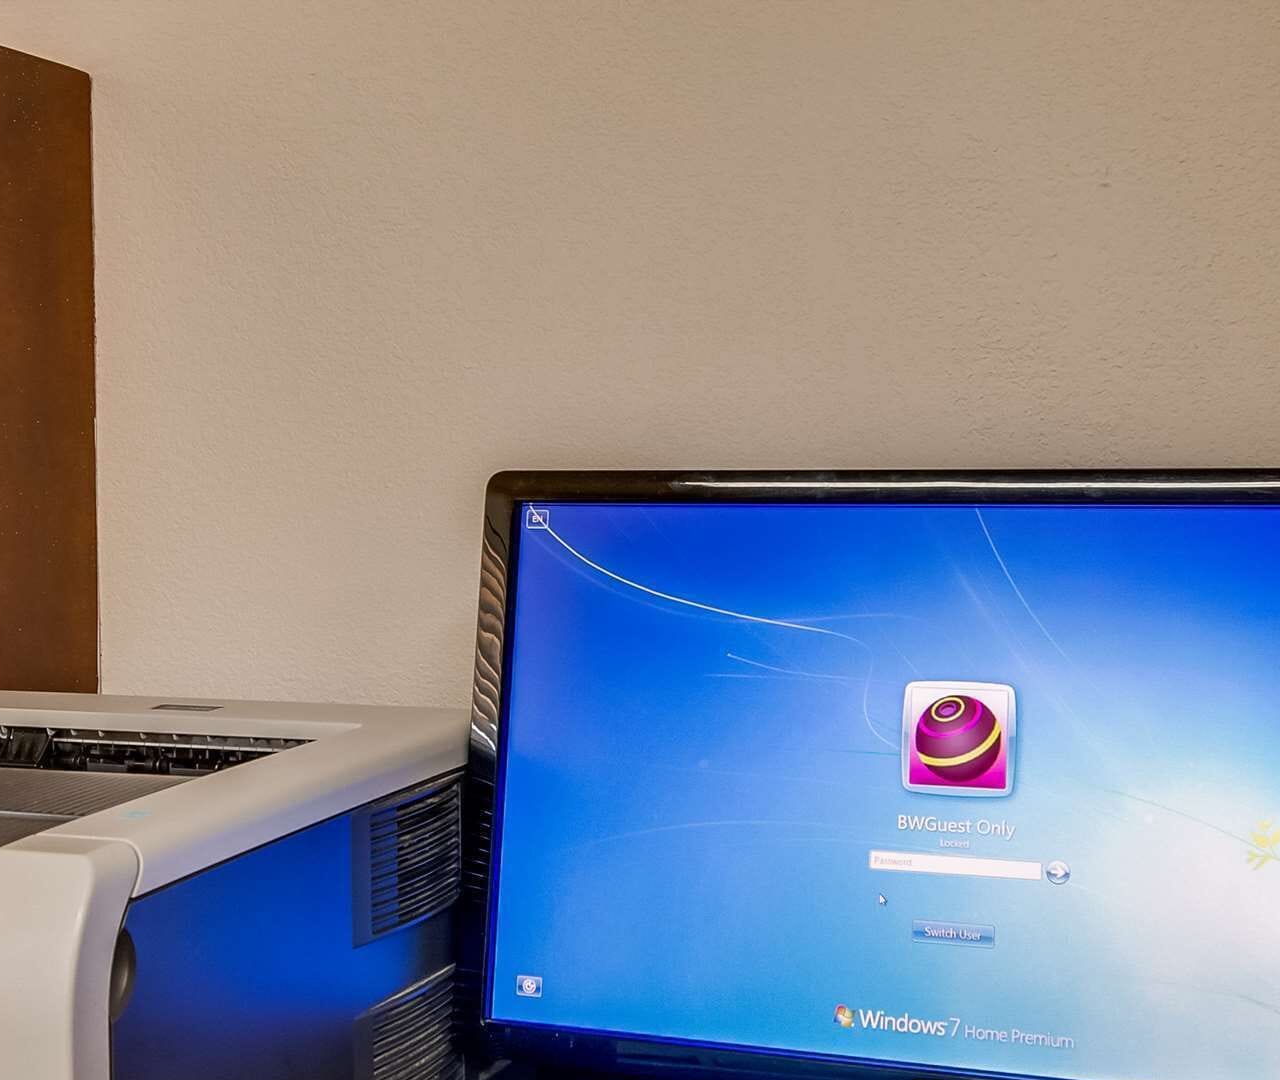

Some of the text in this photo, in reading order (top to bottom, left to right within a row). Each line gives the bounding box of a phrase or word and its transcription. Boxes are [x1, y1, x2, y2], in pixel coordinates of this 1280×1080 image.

[896, 814, 1016, 841] BWGuest Only
[923, 926, 983, 942] Switch User
[858, 1008, 1075, 1049] Windows 7 Home Premium
